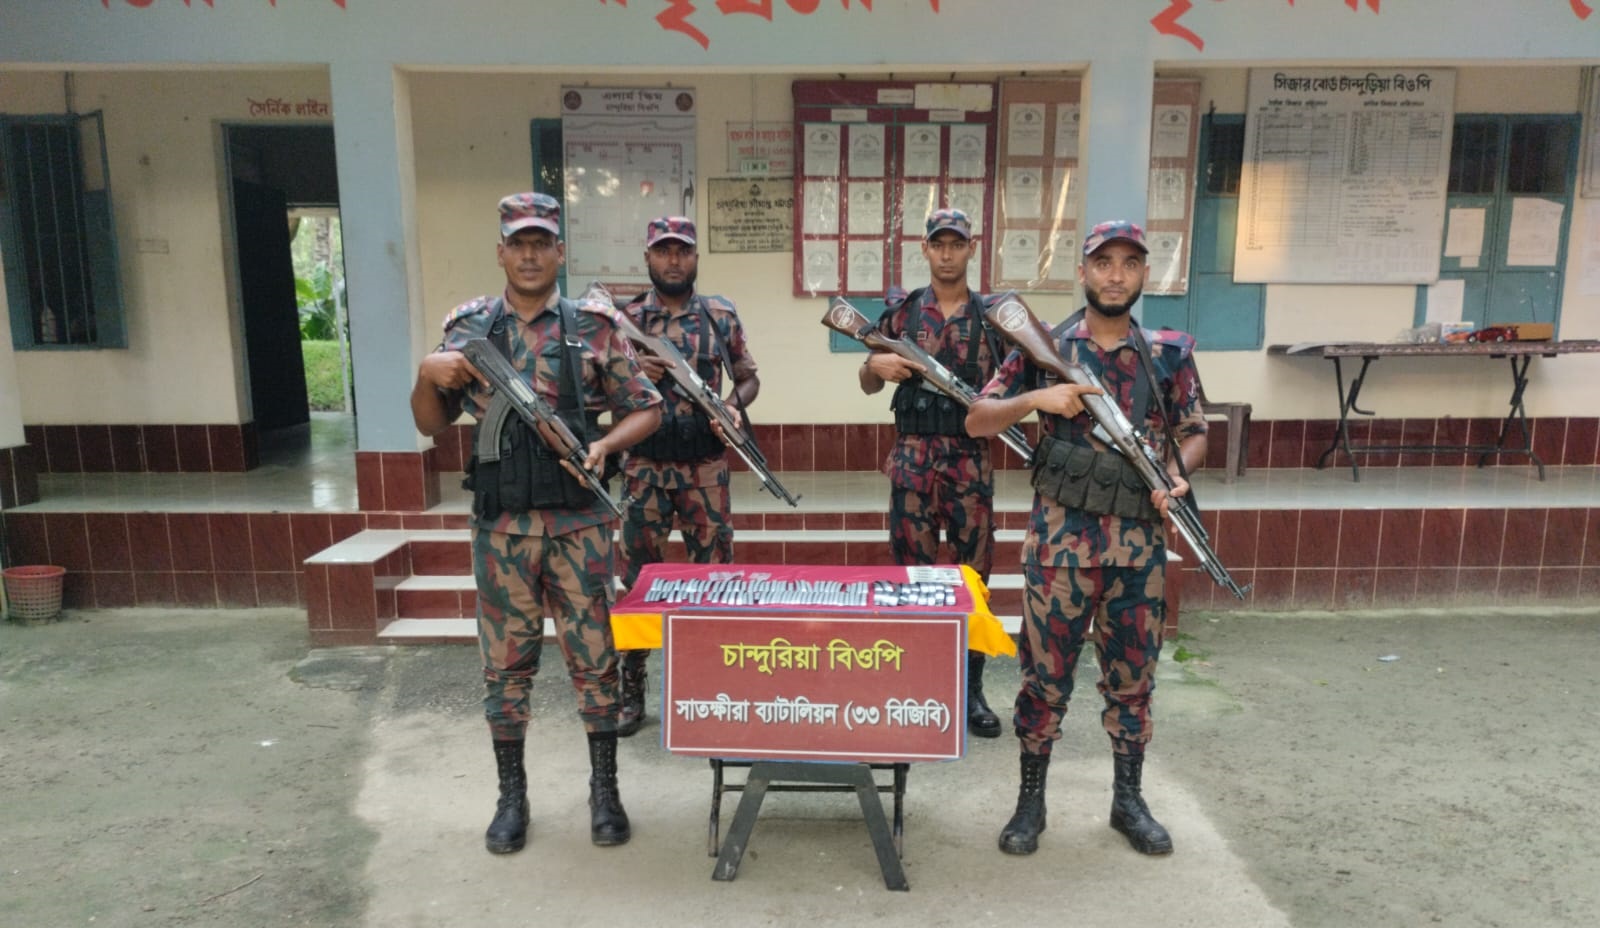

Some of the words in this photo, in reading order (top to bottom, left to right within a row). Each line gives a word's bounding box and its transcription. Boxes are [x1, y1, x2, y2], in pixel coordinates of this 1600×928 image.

[720, 637, 821, 675] চান্দুরিয়া
[828, 638, 904, 671] বিওপি
[675, 693, 750, 724] সাতক্ষীরা
[755, 696, 839, 725] ব্যাটালিয়ন
[844, 701, 880, 730] (৩৩
[885, 698, 951, 732] বিজিবি)
